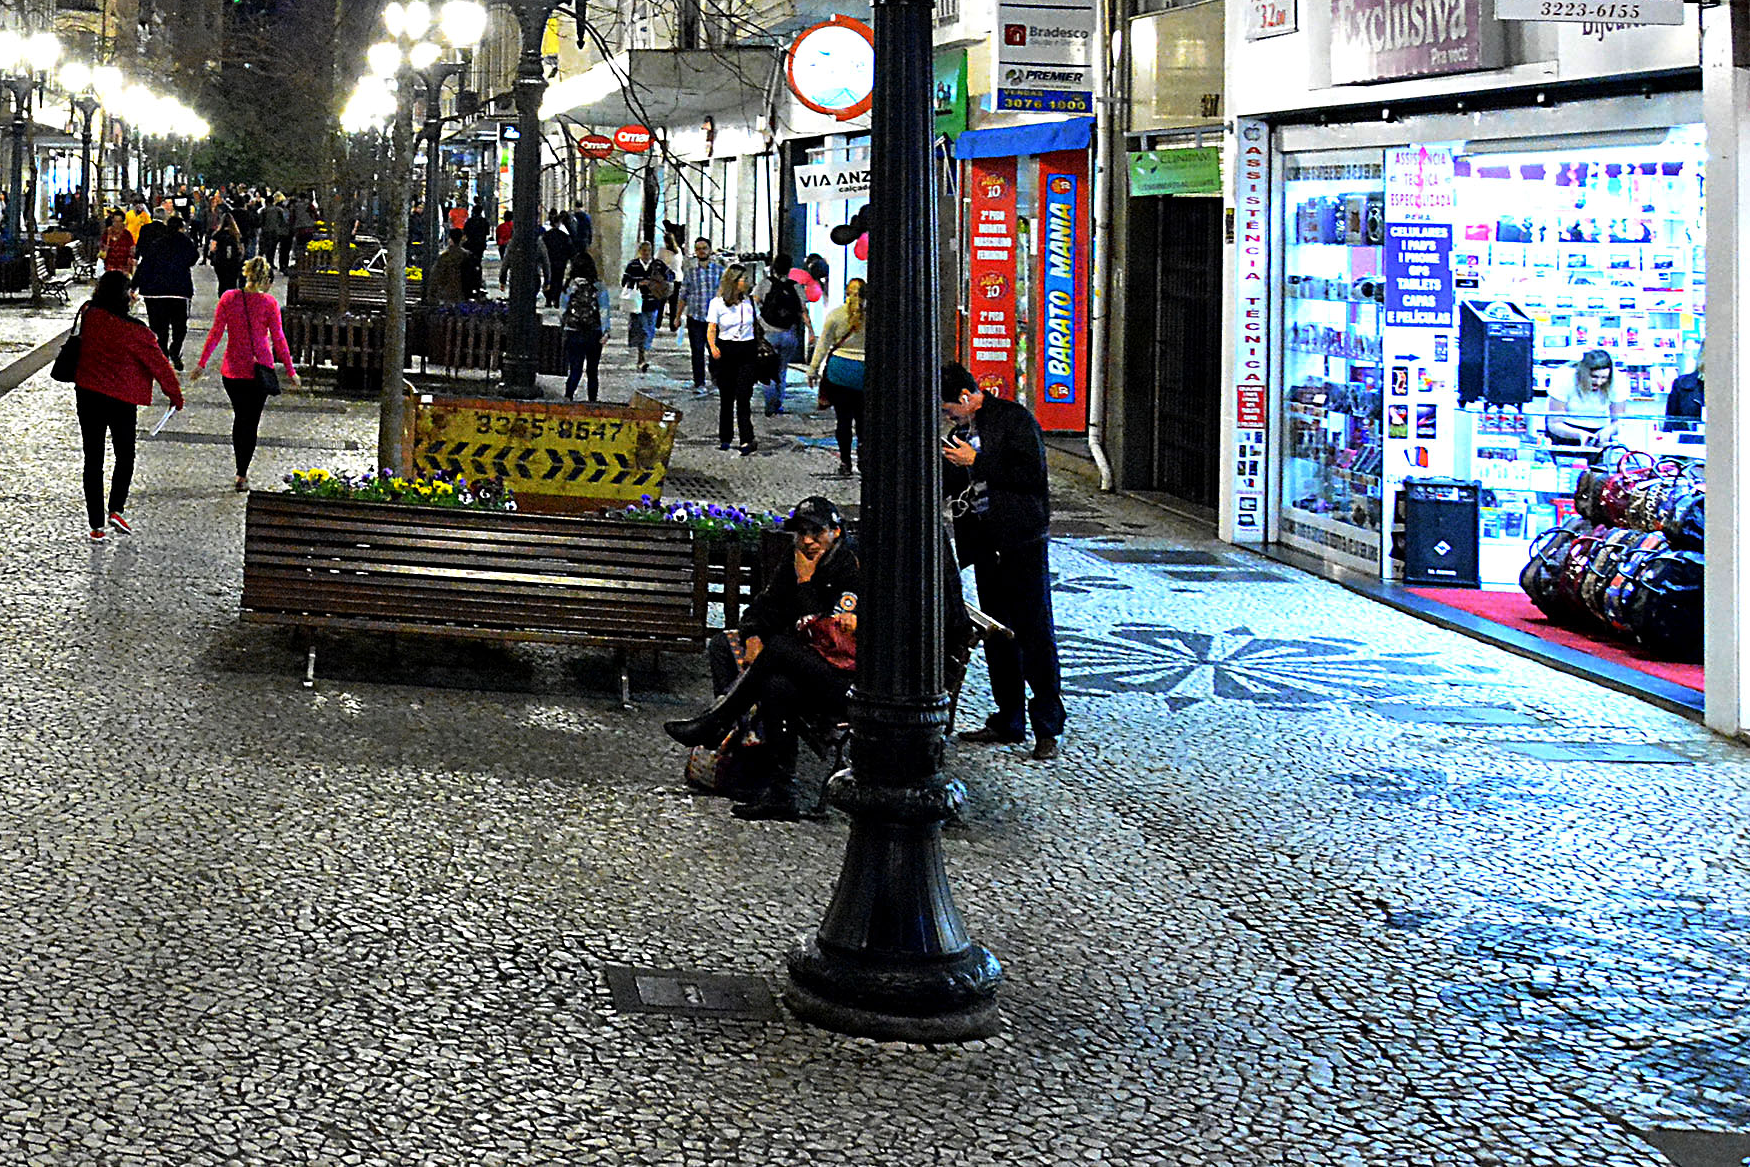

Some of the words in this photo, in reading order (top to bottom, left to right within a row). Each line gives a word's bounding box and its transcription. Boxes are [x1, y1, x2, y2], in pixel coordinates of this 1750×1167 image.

[1540, 2, 1640, 19] 3223-6155
[1029, 26, 1089, 39] Bradesco
[1431, 47, 1448, 66] Pra
[1449, 43, 1468, 64] você
[1026, 70, 1083, 82] PREMIER
[1004, 98, 1043, 110] 3076
[1395, 152, 1447, 166] ASSISNCIA
[799, 174, 832, 188] VIA
[1403, 173, 1439, 186] TECICA
[838, 184, 871, 193] calçad
[987, 185, 1001, 198] 10
[1390, 193, 1451, 208] ESPECLIZADA
[1389, 226, 1449, 238] CELULARES
[1048, 202, 1073, 280] MANIA
[1396, 277, 1442, 291] TABLETS
[985, 285, 1000, 298] 10
[1402, 294, 1437, 308] CAPAS
[1386, 311, 1395, 324] E
[1046, 290, 1073, 377] BARATO
